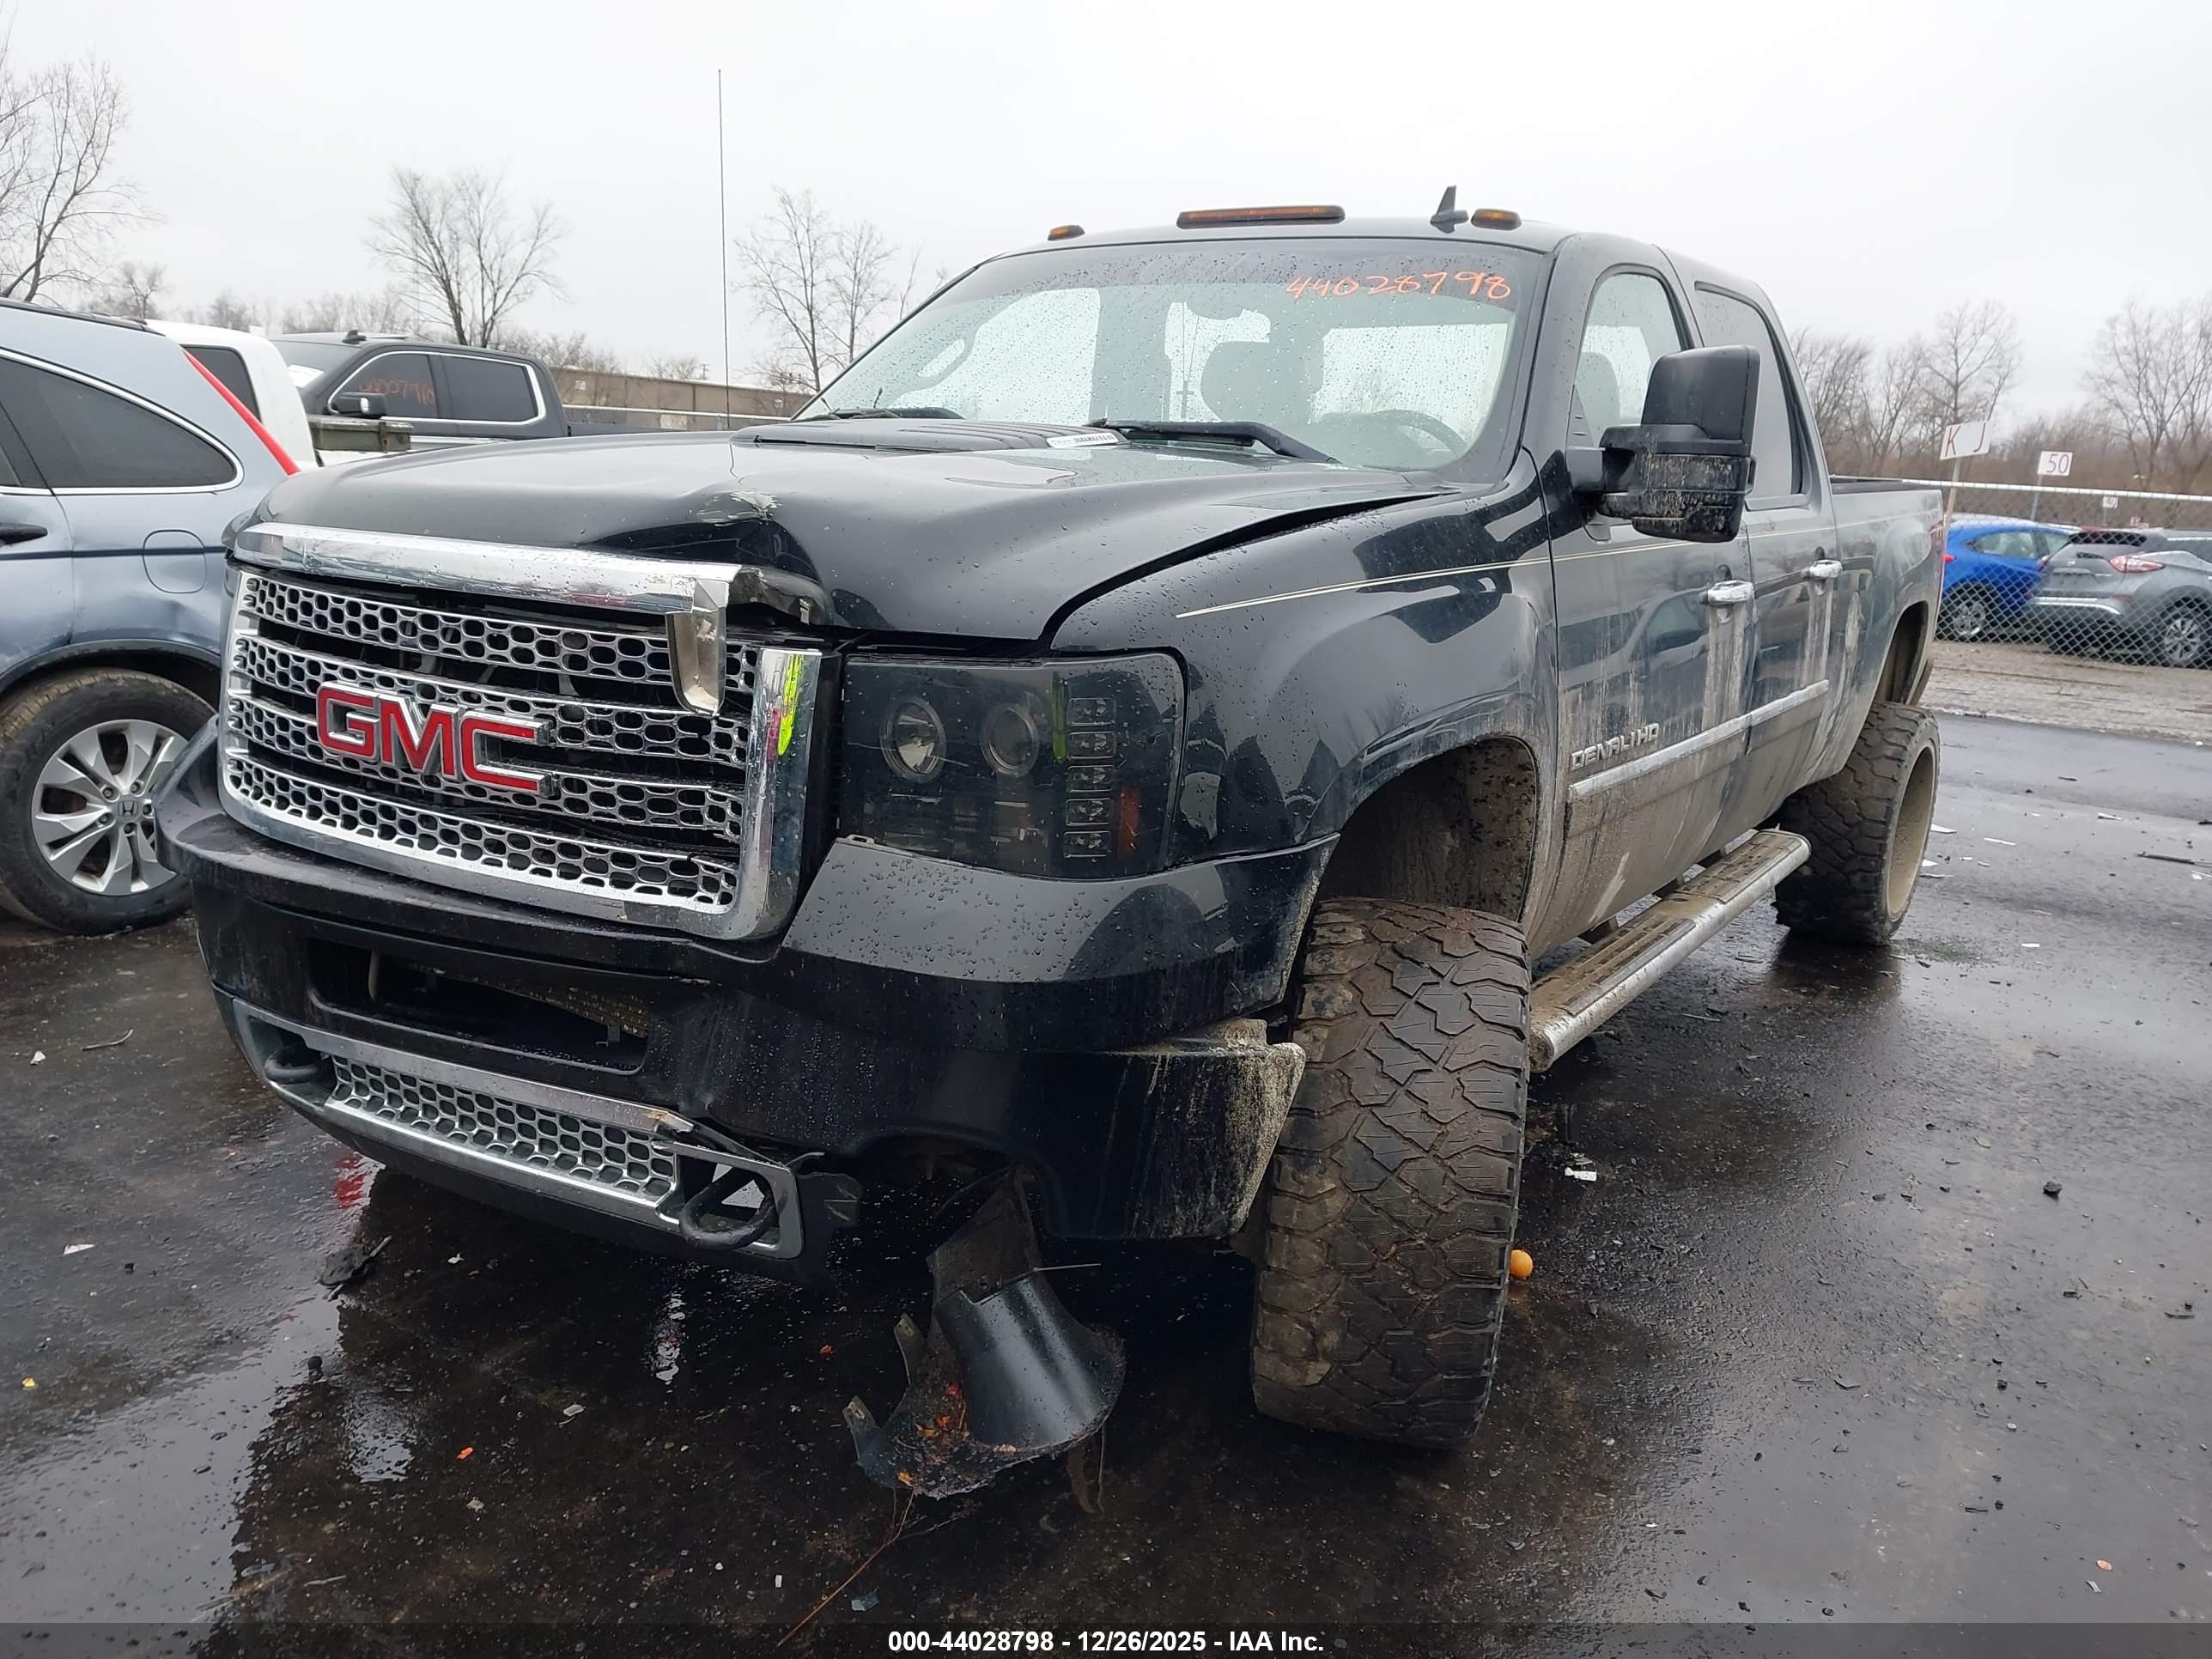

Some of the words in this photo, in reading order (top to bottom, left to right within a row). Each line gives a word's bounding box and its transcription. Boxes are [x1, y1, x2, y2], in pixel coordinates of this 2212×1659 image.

[1285, 270, 1511, 299] 44028798
[1945, 426, 1960, 457] K
[2046, 453, 2069, 474] 50
[316, 680, 555, 798] GMC
[1571, 732, 1635, 771] DENALI
[1638, 722, 1659, 745] HD
